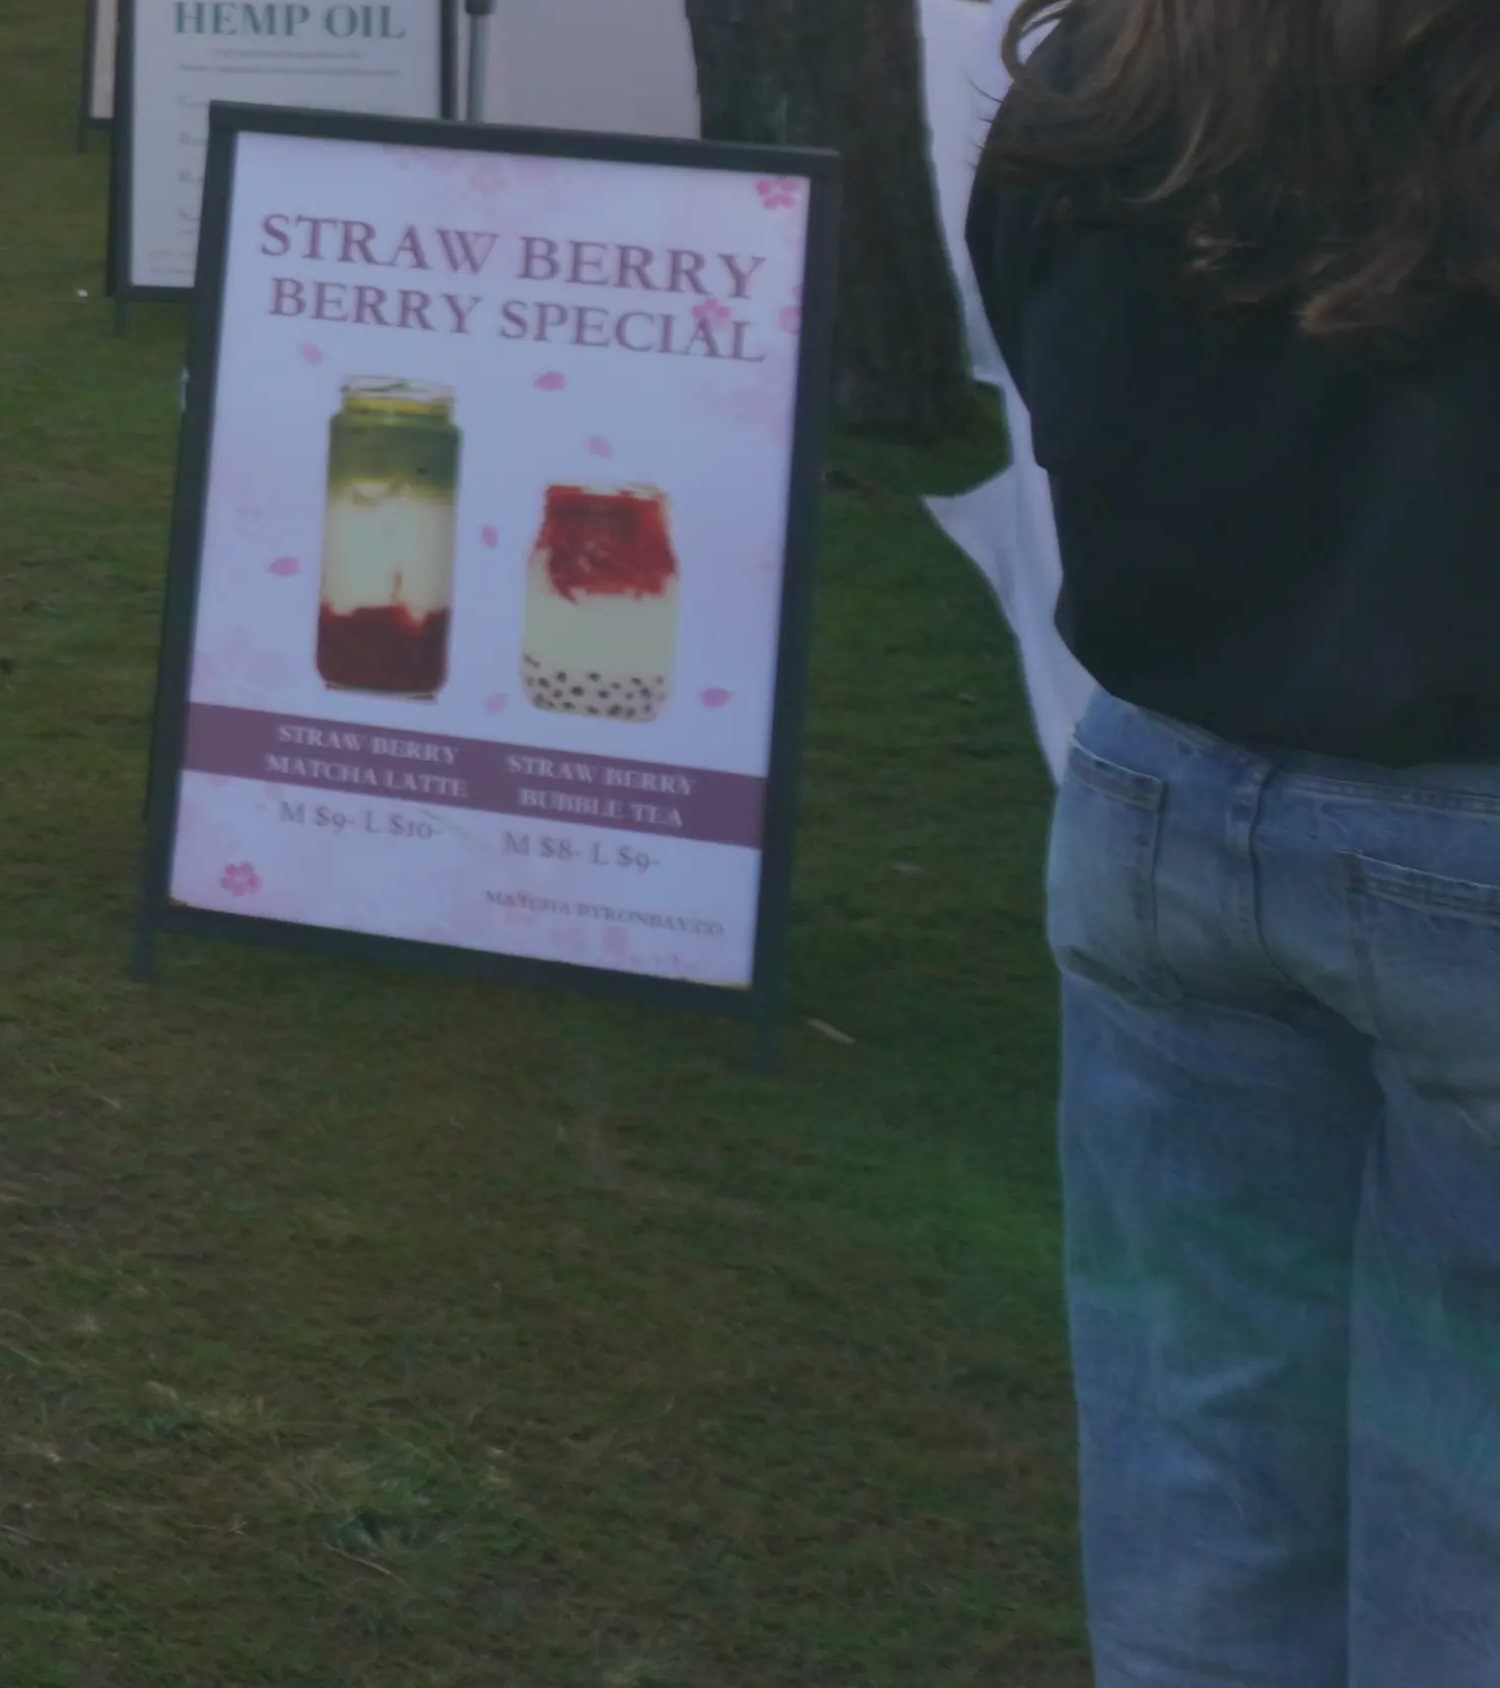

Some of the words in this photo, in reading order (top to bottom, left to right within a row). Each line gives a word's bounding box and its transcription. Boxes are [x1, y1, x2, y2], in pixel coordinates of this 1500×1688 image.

[173, 1, 311, 38] HEMP
[323, 3, 406, 39] OIL
[260, 213, 500, 275] STRAW
[516, 235, 766, 300] BERRY
[268, 276, 484, 334] BERRY
[499, 299, 766, 363] SPECIAL
[278, 724, 367, 752] STRAW
[370, 736, 460, 764] BERRY
[265, 753, 378, 786] MATCHA
[384, 769, 469, 798] LATTE
[506, 754, 599, 784] STRAW
[603, 767, 697, 797] BERRY
[280, 800, 306, 826] M
[363, 810, 381, 834] L
[518, 787, 625, 820] BUBBLE
[631, 803, 683, 829] TEA
[502, 830, 530, 857] M
[591, 841, 610, 865] L
[484, 890, 570, 917] MATCHA
